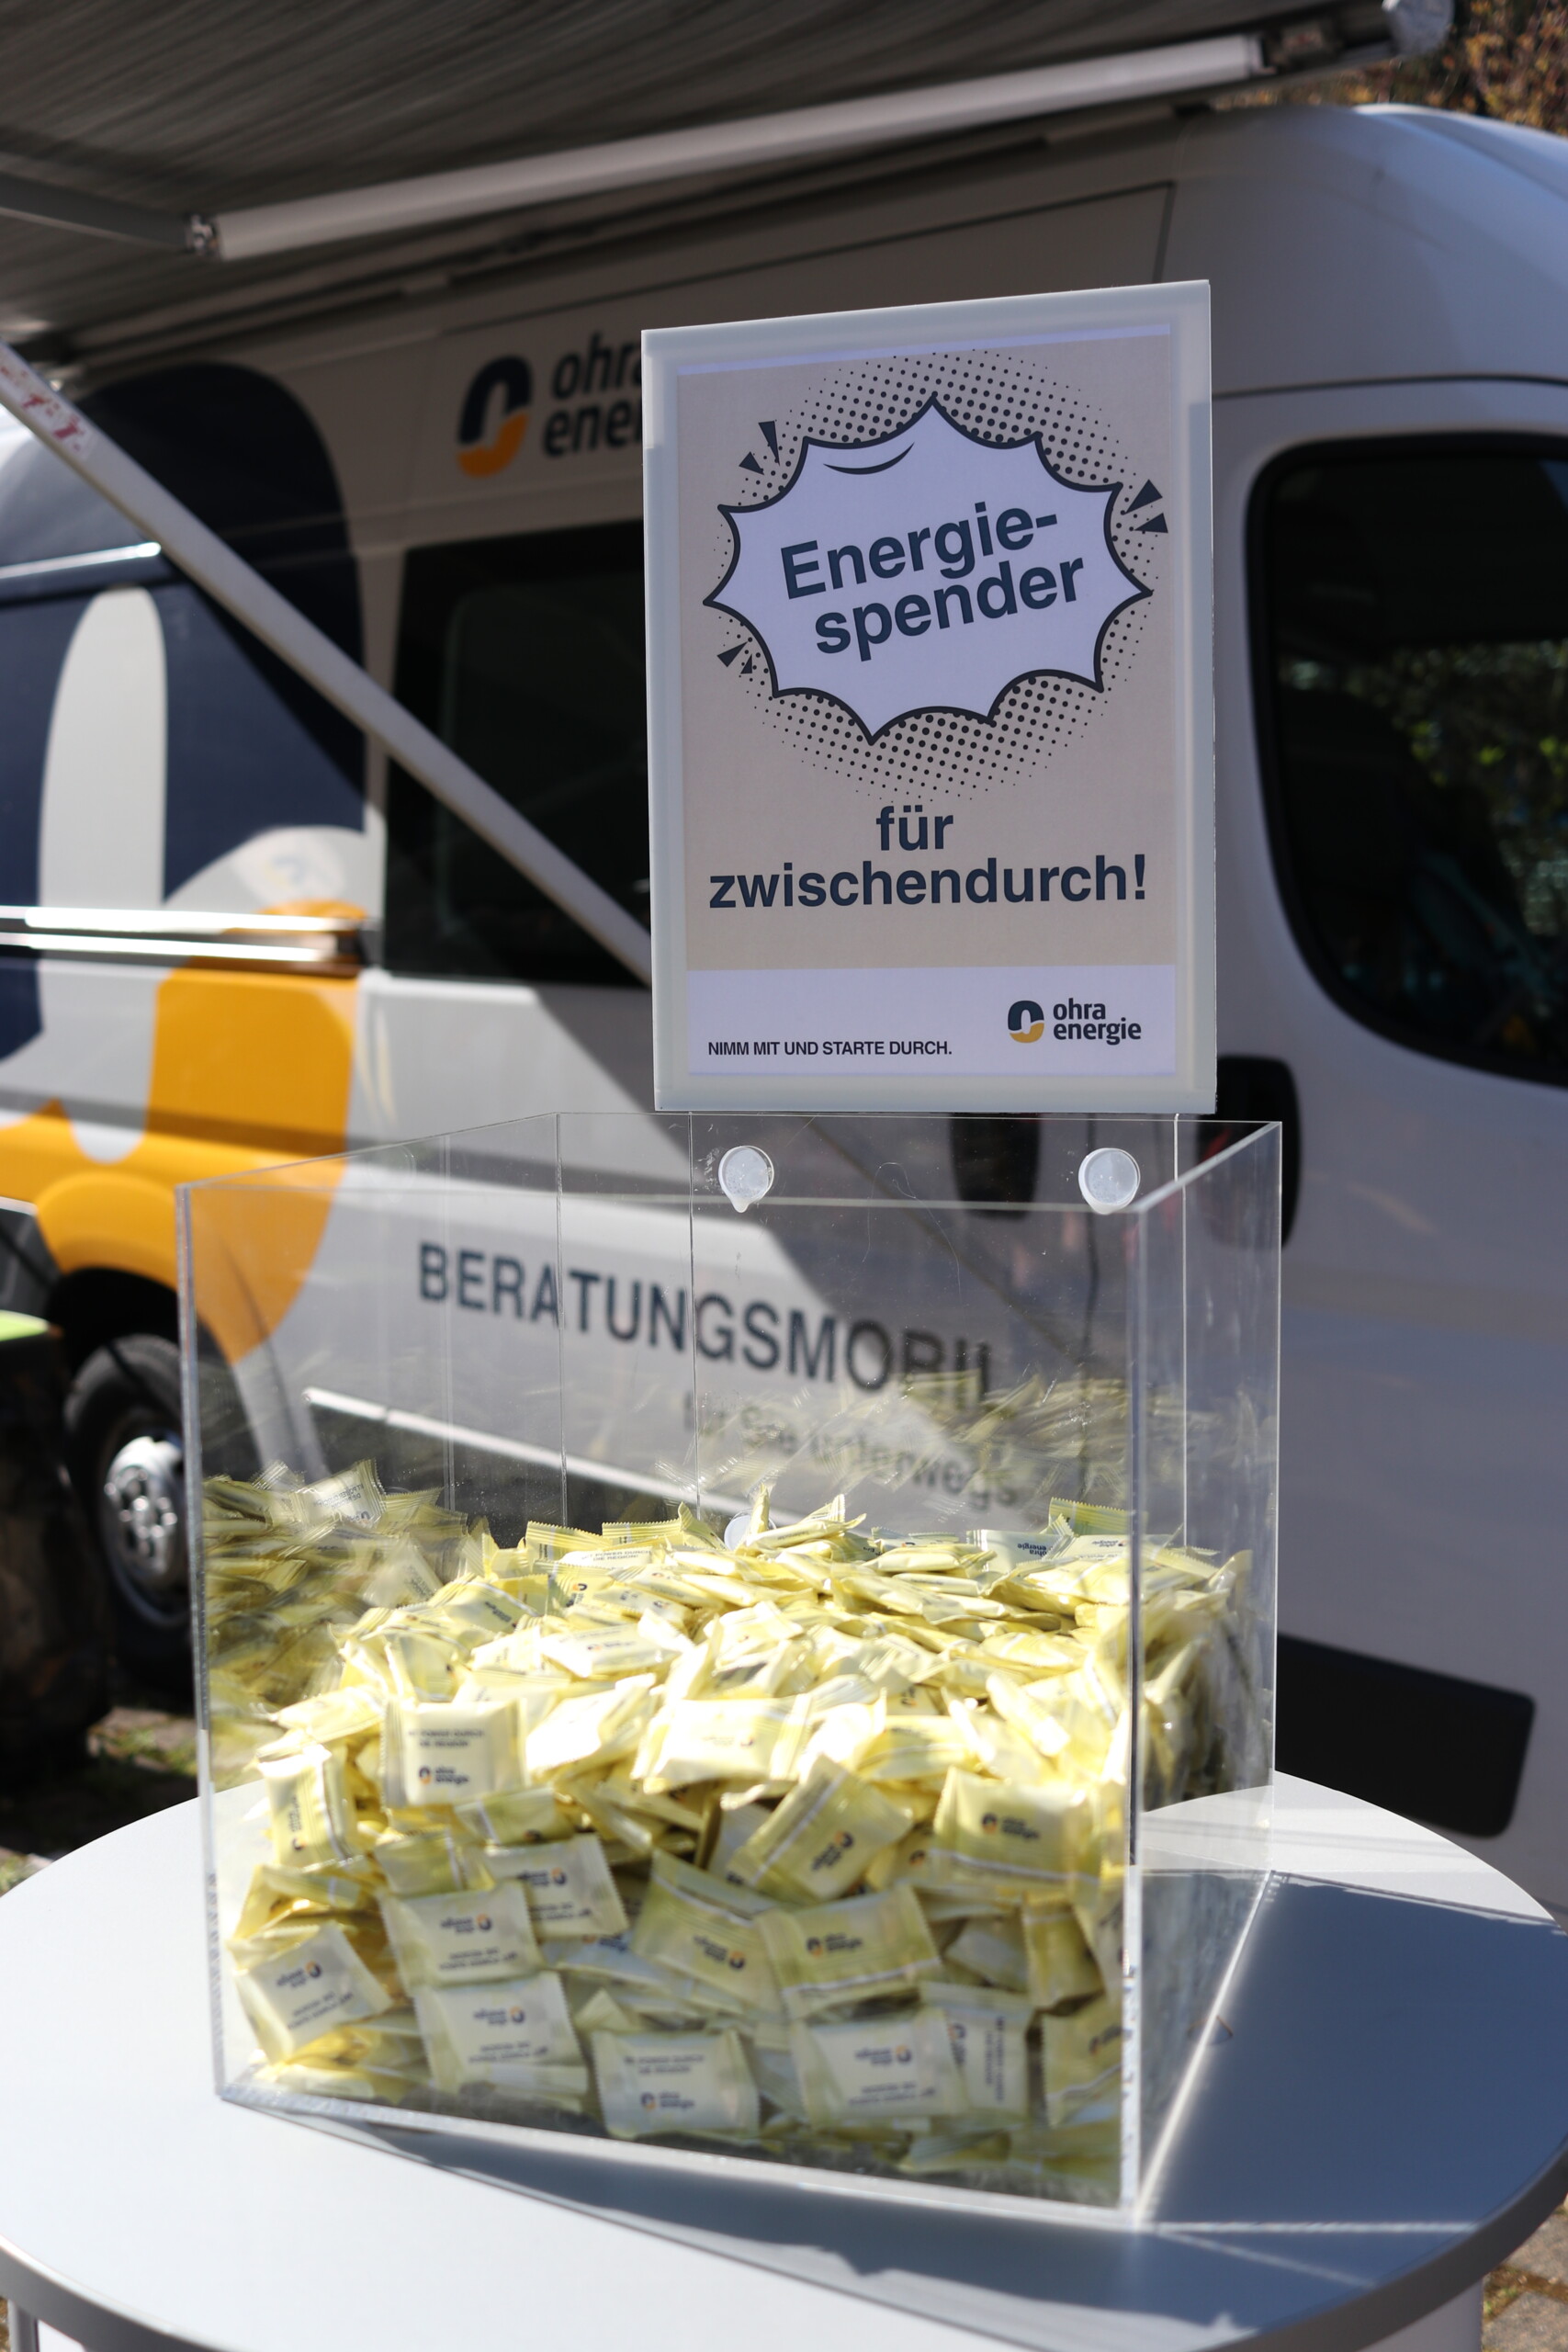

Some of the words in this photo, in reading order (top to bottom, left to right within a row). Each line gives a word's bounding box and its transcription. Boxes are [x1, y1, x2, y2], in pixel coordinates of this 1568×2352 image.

[780, 501, 1058, 600] Energie-
[815, 557, 1084, 662] spender
[875, 804, 954, 852] für
[709, 854, 1145, 909] zwischendurch!
[1053, 997, 1106, 1021] ohra
[1053, 1016, 1142, 1046] energie
[708, 1041, 750, 1056] NIMM
[753, 1041, 781, 1056] MIT
[784, 1041, 819, 1056] UND
[822, 1041, 886, 1056] STARTE
[889, 1040, 953, 1056] DURCH.
